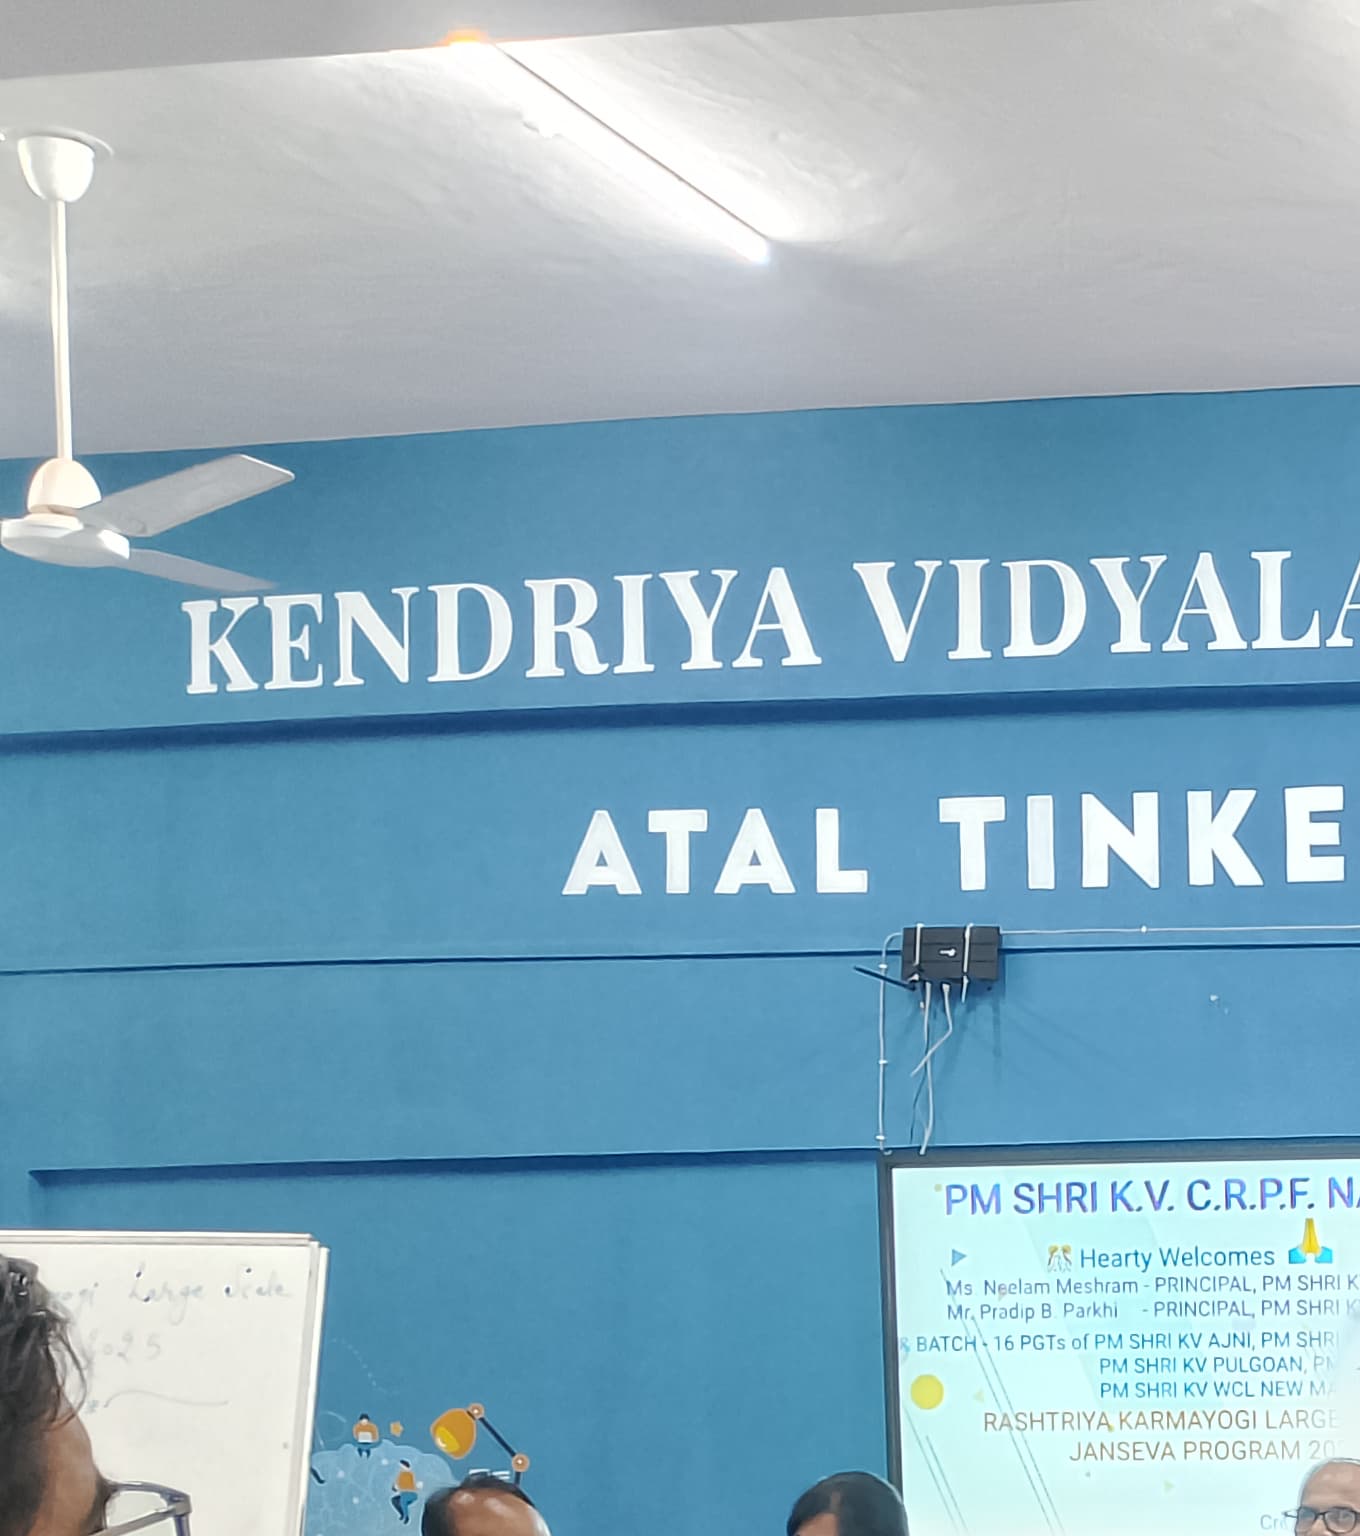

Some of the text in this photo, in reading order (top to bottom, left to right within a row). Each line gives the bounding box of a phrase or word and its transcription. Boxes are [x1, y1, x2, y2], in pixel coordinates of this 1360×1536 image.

[182, 566, 821, 695] KENDRIYA
[562, 808, 868, 896] ATAL
[945, 1183, 1001, 1216] PM
[1013, 1180, 1098, 1214] SHRI
[1110, 1179, 1175, 1213] K.V.
[1187, 1177, 1315, 1212] C.R.P.F.
[1080, 1244, 1276, 1273] Hearty Welcomes
[984, 1277, 1050, 1296] Neelam
[1056, 1276, 1139, 1295] Meshram
[1263, 1275, 1291, 1292] PM
[1297, 1274, 1341, 1291] SHRI
[980, 1302, 1035, 1323] Pradip
[1063, 1301, 1119, 1318] Parkhi
[1261, 1299, 1290, 1316] PM
[1296, 1299, 1339, 1316] SHRI
[916, 1335, 977, 1352] BATCH
[994, 1335, 1015, 1351] 16
[1020, 1334, 1066, 1351] PGTs
[1071, 1333, 1090, 1350] of
[1094, 1333, 1124, 1350] PM
[1129, 1333, 1172, 1349] SHRI
[1178, 1332, 1203, 1349] KV
[1261, 1331, 1290, 1348] PM
[1099, 1358, 1128, 1374] PM
[1134, 1357, 1176, 1374] SHRI
[1183, 1357, 1208, 1373] KV
[1100, 1382, 1129, 1398] PM
[1135, 1382, 1177, 1398] SHRI
[1184, 1382, 1209, 1398] KV
[1214, 1381, 1255, 1397] WCL
[1261, 1381, 1304, 1397] NEW
[984, 1409, 1339, 1432] RASHTRIYA KARMAYOGI LARGE
[1069, 1441, 1176, 1461] JANSEVA
[1183, 1440, 1301, 1461] PROGRAM
